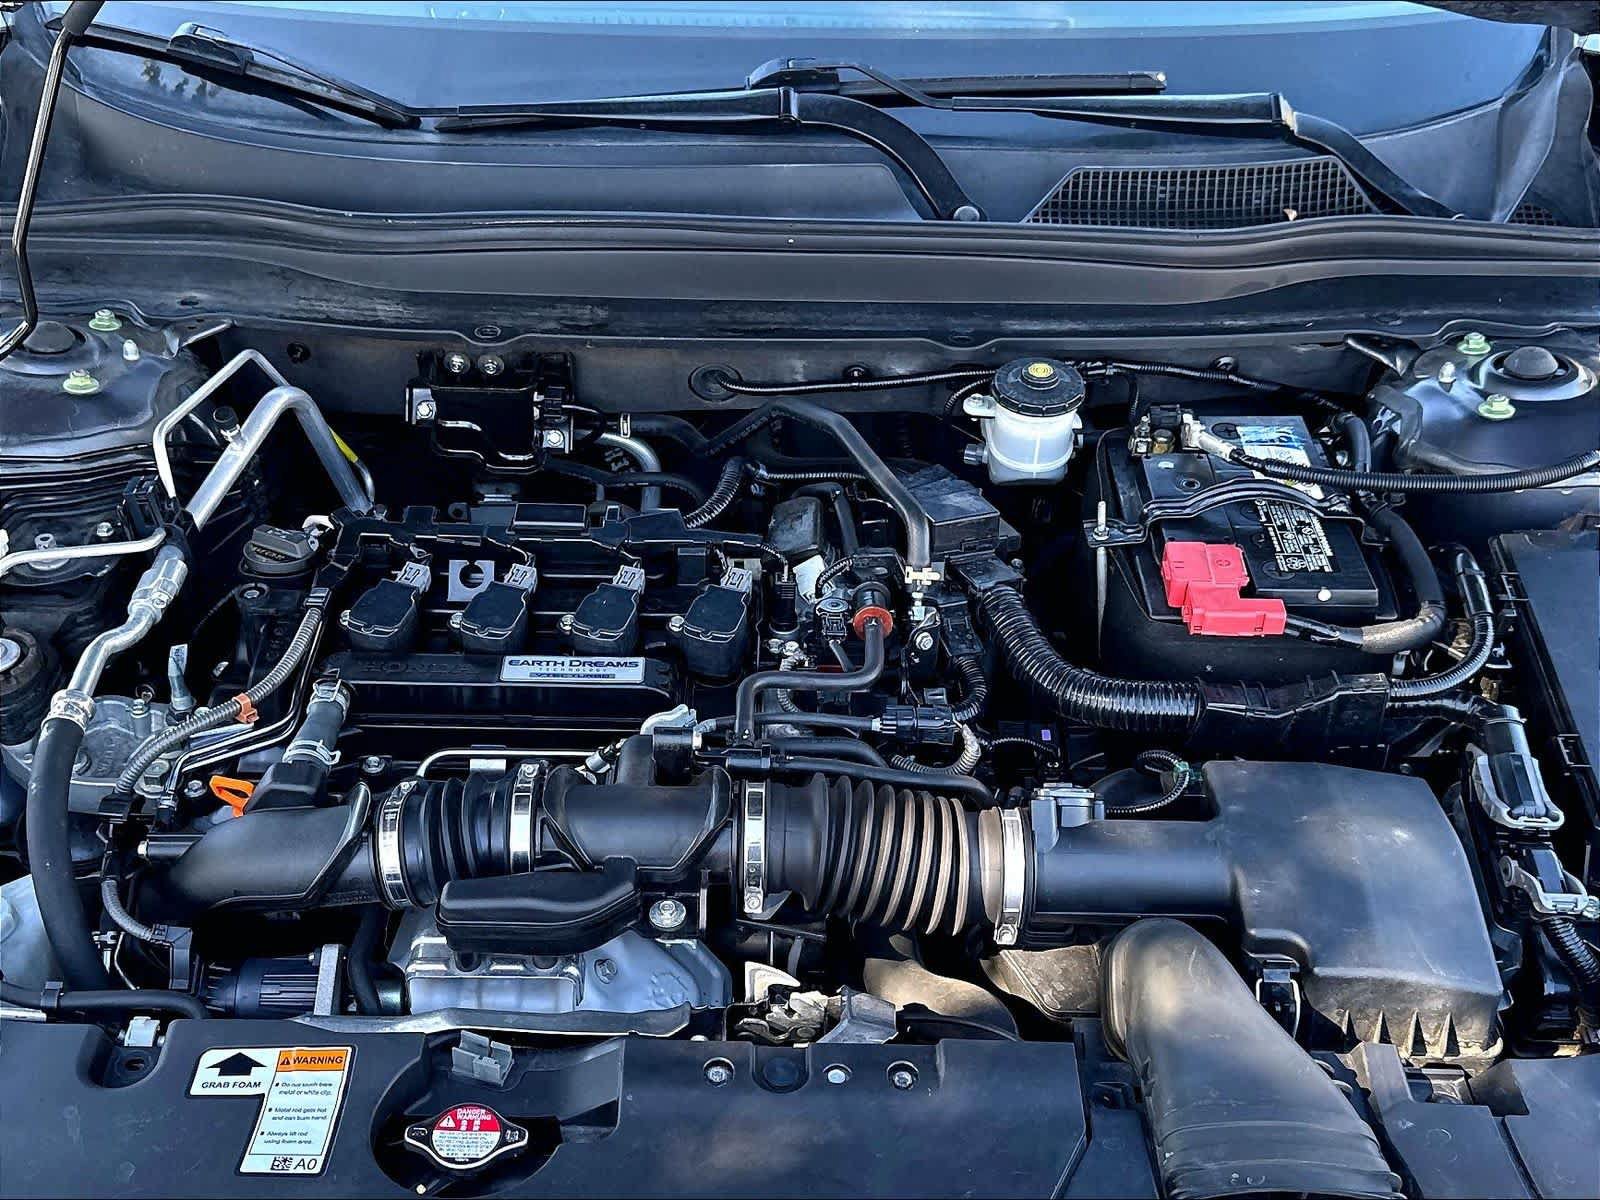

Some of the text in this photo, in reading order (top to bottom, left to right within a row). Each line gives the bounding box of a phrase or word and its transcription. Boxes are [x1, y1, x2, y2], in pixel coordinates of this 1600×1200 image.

[508, 659, 640, 668] EARTH DREAMS
[293, 1056, 344, 1065] WARNING
[201, 1081, 230, 1089] GRAB
